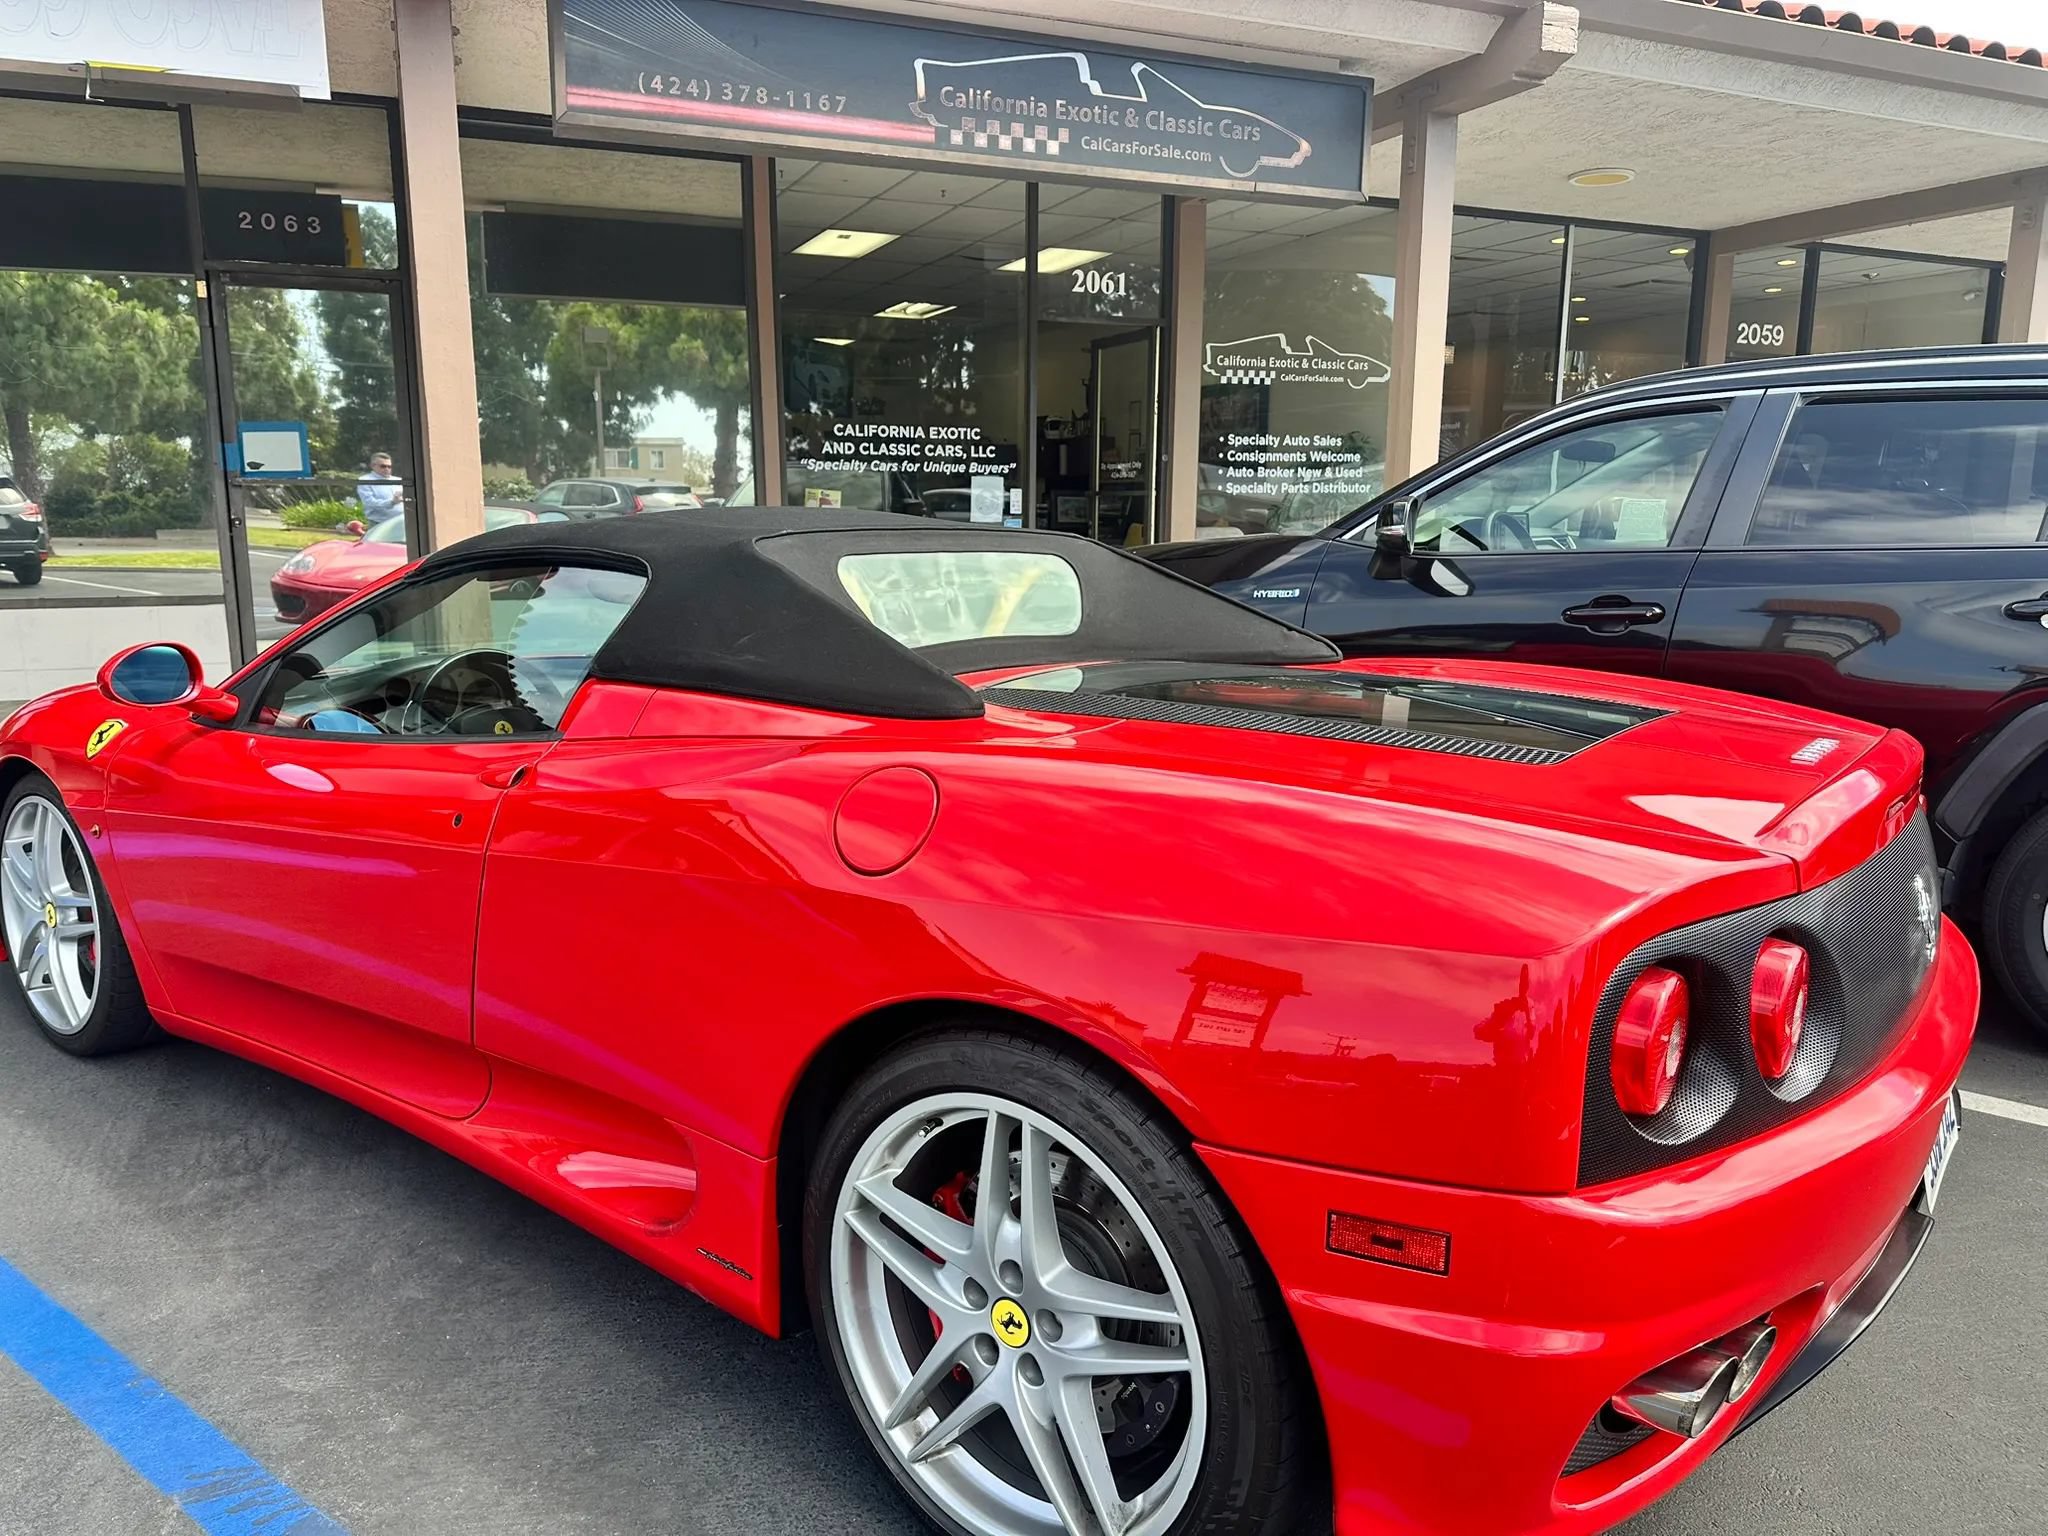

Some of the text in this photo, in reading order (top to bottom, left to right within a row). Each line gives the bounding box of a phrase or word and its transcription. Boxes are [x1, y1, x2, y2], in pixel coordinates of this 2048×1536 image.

[638, 71, 847, 113] (424) 378-1167
[939, 85, 1261, 142] California Exotic & Classic Cars
[1080, 136, 1212, 162] CalCarsForSale.com
[238, 211, 321, 234] 2063
[1071, 268, 1127, 296] 2061
[1736, 322, 1784, 346] 2059
[1216, 354, 1369, 371] California Exotic & Classic Cars
[1280, 373, 1345, 383] CalCarsForSale.com
[833, 423, 981, 441] CALIFORNIA EXOTIC
[1227, 433, 1343, 447] Specialty Auto Sales
[821, 441, 996, 460] AND CLASSIC CARS, LLC
[1226, 449, 1361, 464] Consignments Welcome
[870, 459, 899, 472] Cars
[900, 460, 921, 472] for
[923, 460, 966, 475] Unique
[1226, 466, 1363, 479] Auto Broker New & Used
[1225, 482, 1372, 496] Specialty Parts Distributor
[1253, 588, 1295, 599] HYBRID
